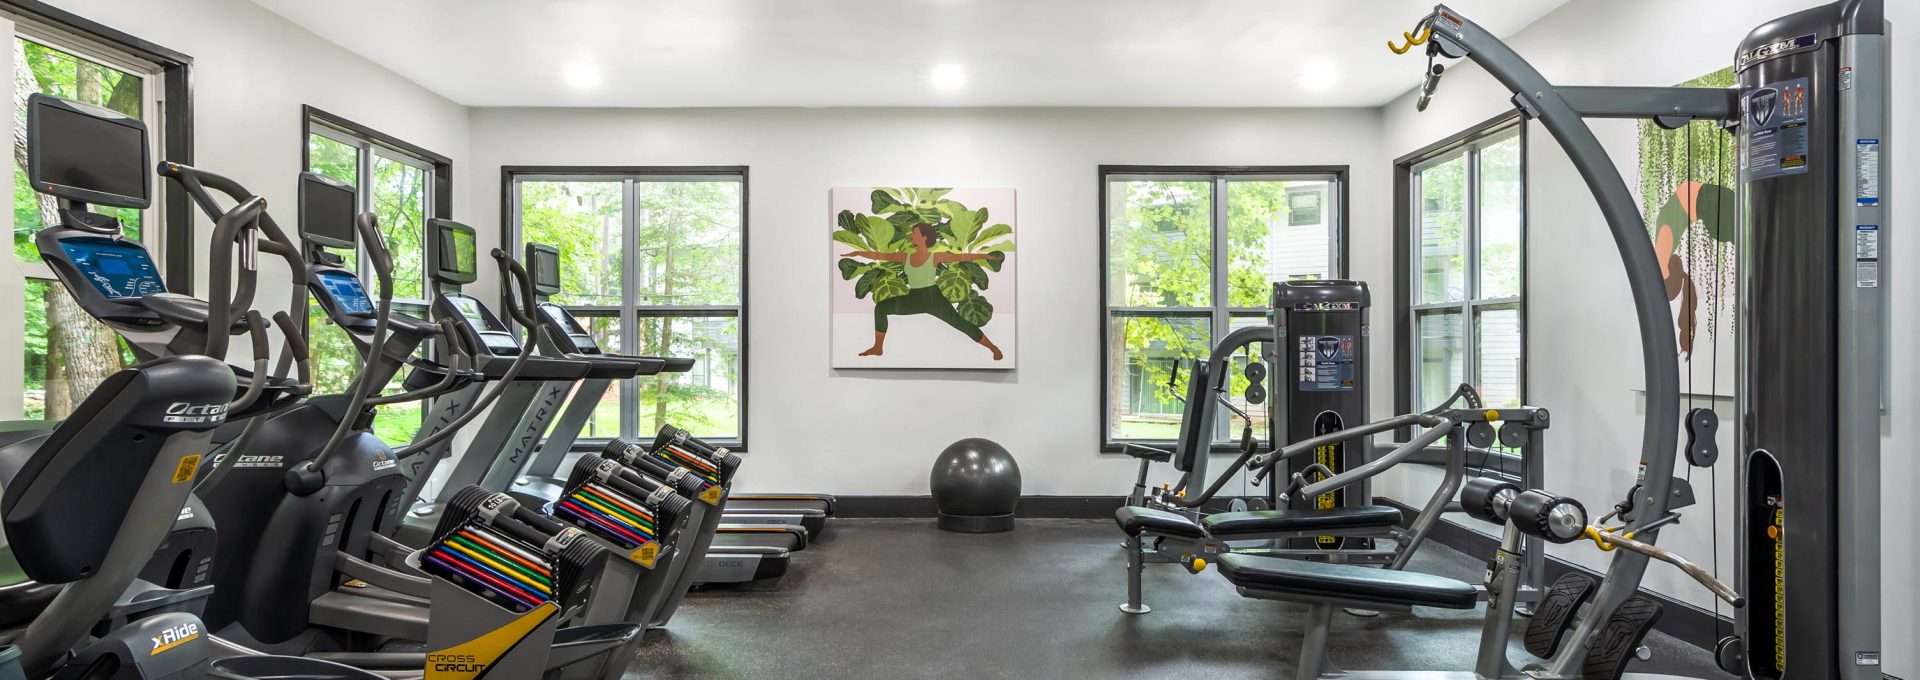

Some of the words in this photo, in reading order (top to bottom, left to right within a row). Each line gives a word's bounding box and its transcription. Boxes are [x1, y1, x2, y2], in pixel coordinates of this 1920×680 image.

[166, 401, 231, 415] Octan
[509, 386, 561, 464] MATRIX
[213, 453, 284, 463] Otane
[151, 623, 198, 650] xRide
[427, 654, 475, 663] CROSS
